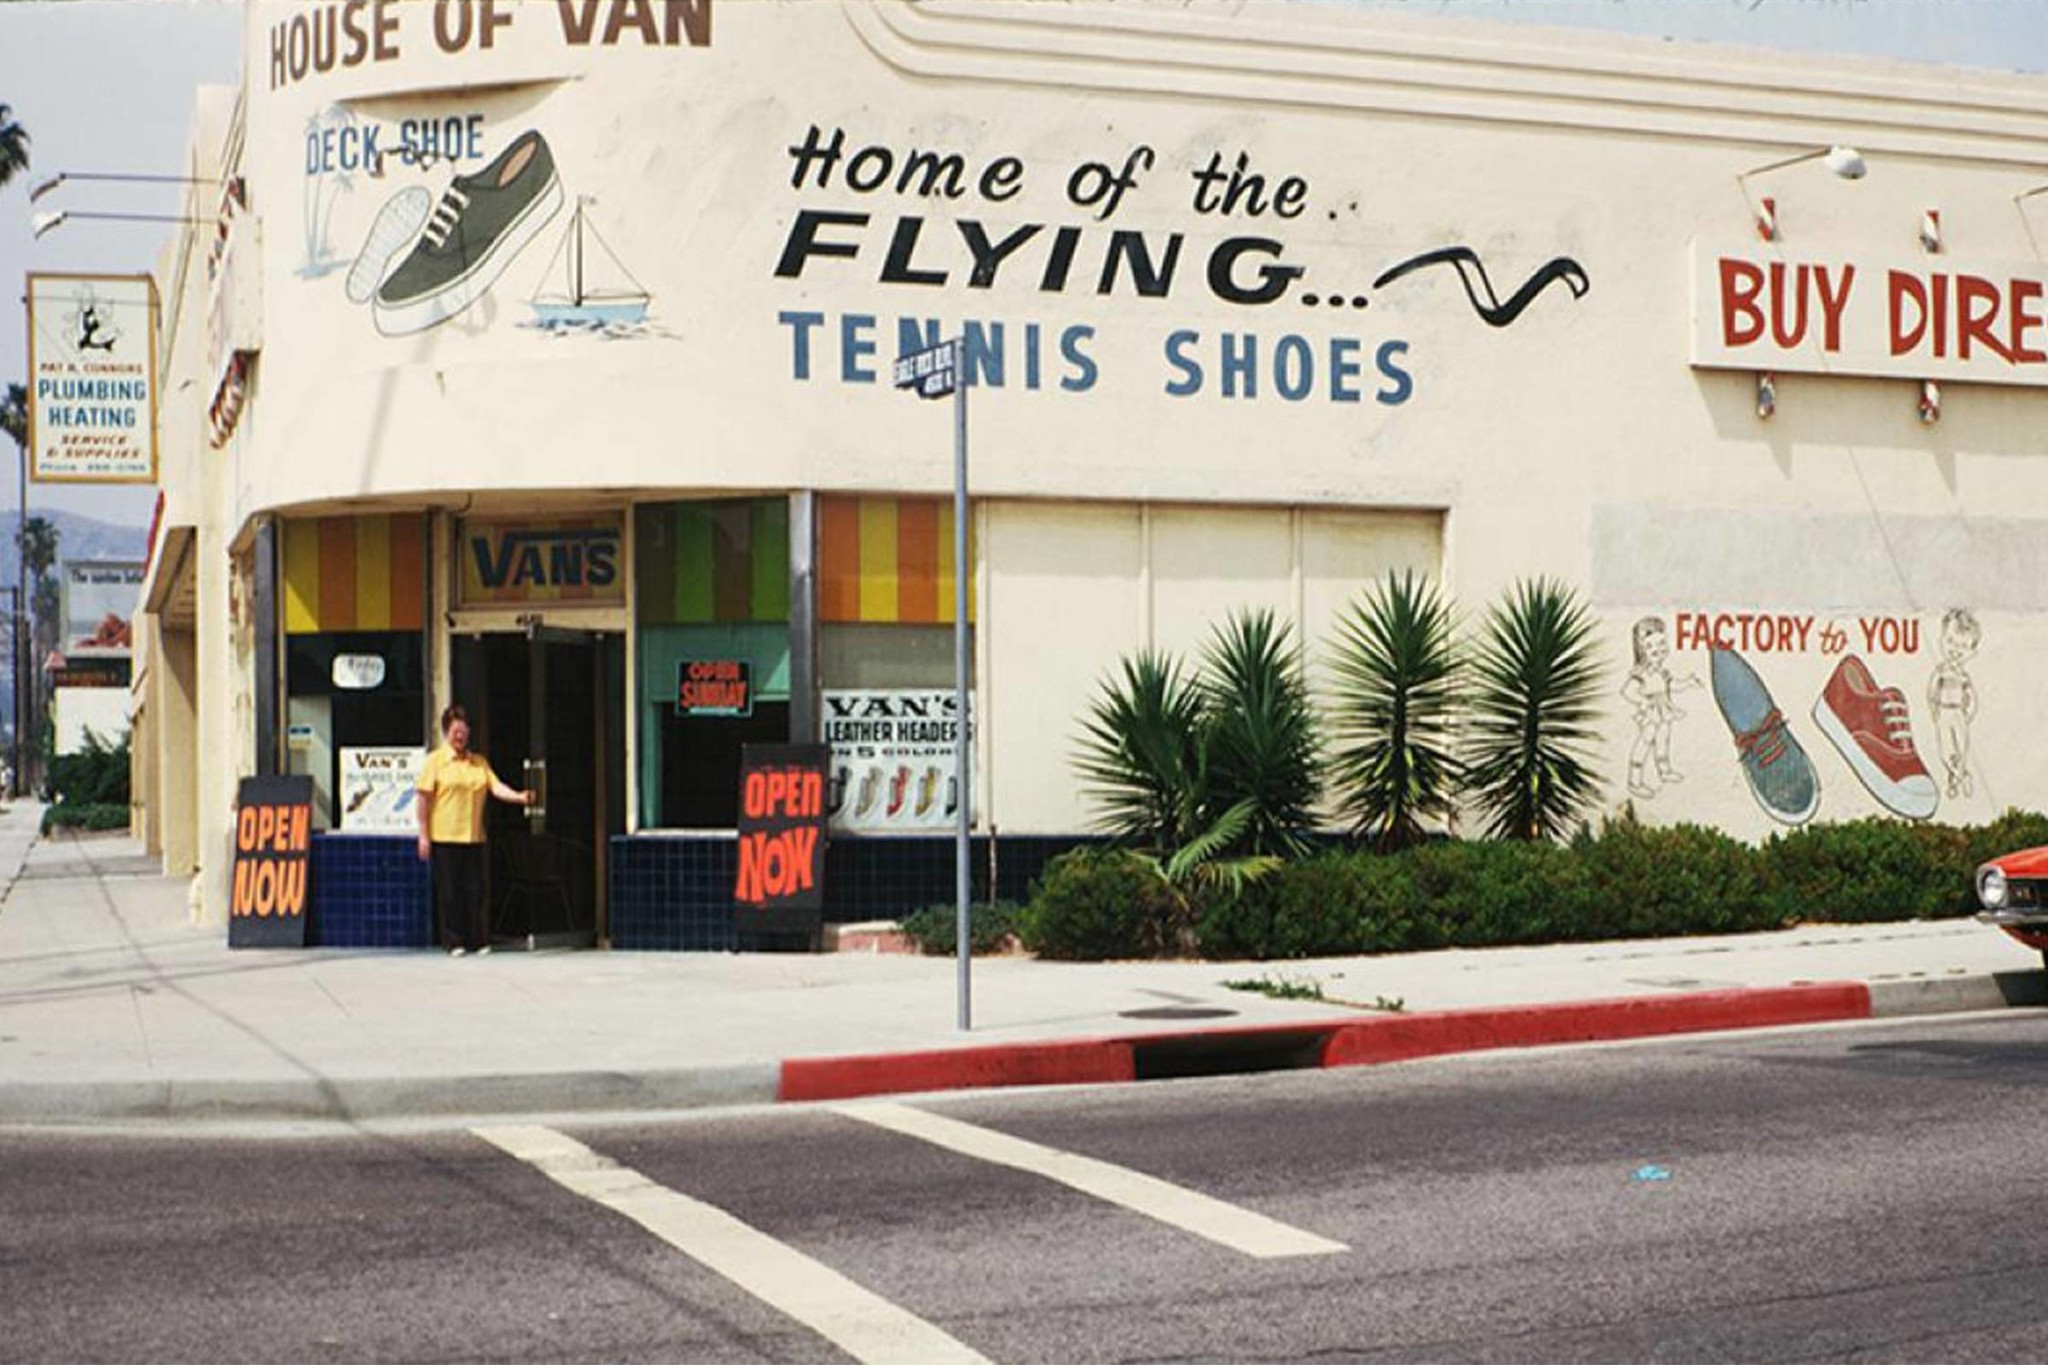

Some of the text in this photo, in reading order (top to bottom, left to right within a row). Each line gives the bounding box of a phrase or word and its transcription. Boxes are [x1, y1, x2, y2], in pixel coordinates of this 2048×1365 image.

[270, 0, 400, 91] HOUSE
[433, 0, 512, 53] OF
[305, 114, 485, 175] DECK SHOE
[788, 124, 1308, 222] Home of the
[1718, 257, 1855, 353] BUY
[778, 311, 1098, 392] TENNIS
[1164, 330, 1414, 406] SHOES
[39, 379, 146, 401] PLUMBING
[48, 407, 136, 428] HEATING
[1676, 613, 1919, 654] FACTORY to YOU
[689, 661, 739, 680] OPEN
[681, 682, 746, 708] SUNDAY
[825, 720, 893, 743] LEATHER
[857, 746, 876, 759] 5
[744, 771, 823, 819] OPEN
[239, 804, 309, 851] OPEN
[735, 825, 819, 902] NOW
[232, 859, 306, 917] NOW
